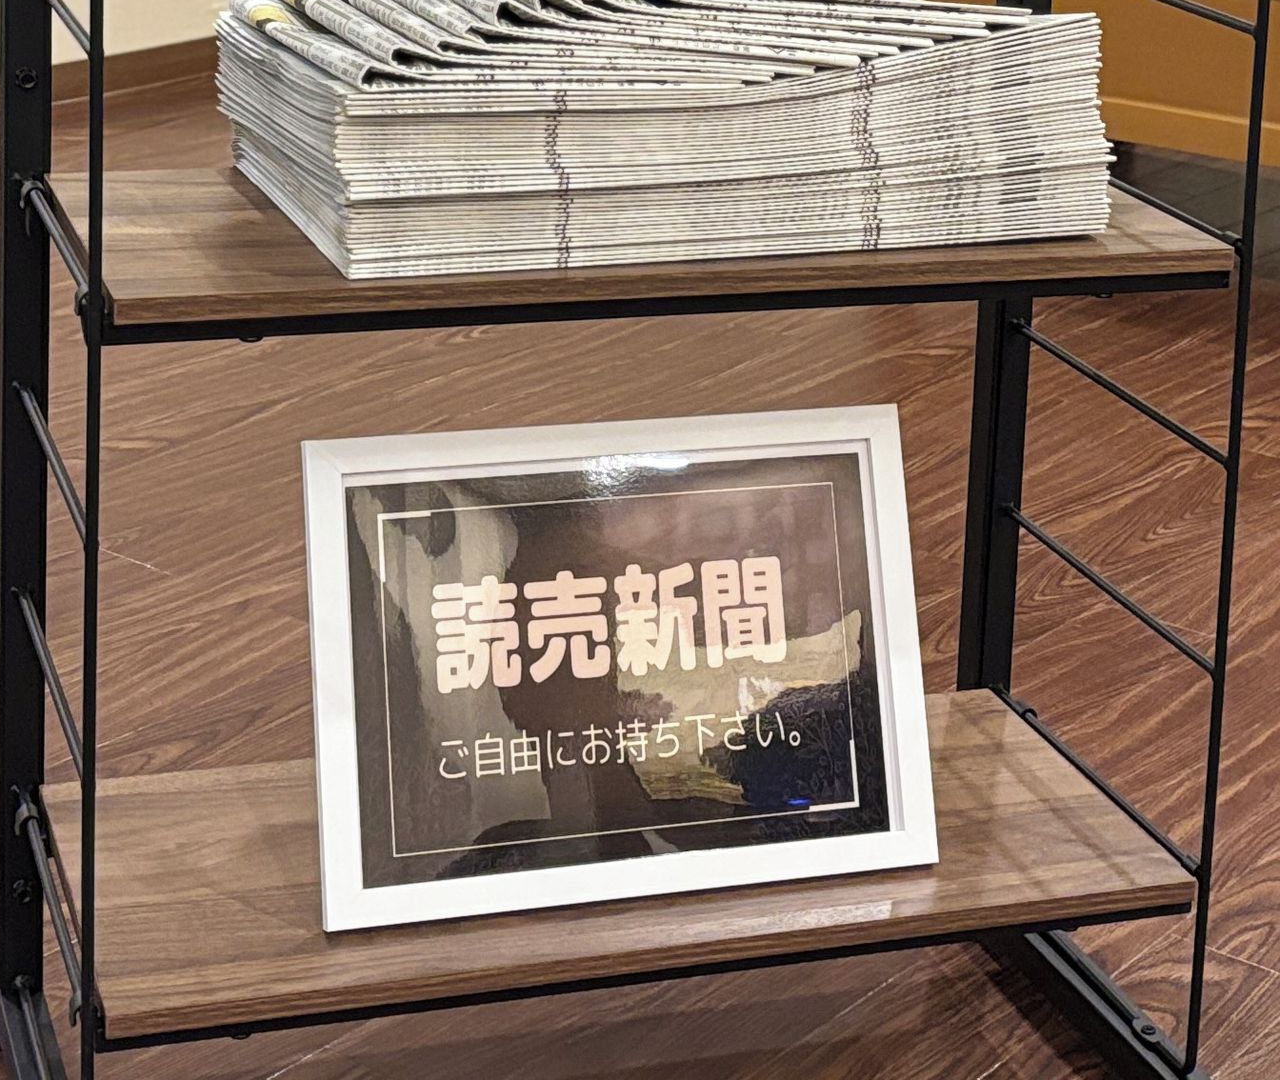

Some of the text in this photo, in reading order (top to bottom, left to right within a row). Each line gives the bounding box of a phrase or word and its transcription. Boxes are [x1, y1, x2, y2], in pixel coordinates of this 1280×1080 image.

[430, 555, 788, 694] 読売新聞
[438, 709, 802, 780] ご自由にお持ち下さい。
